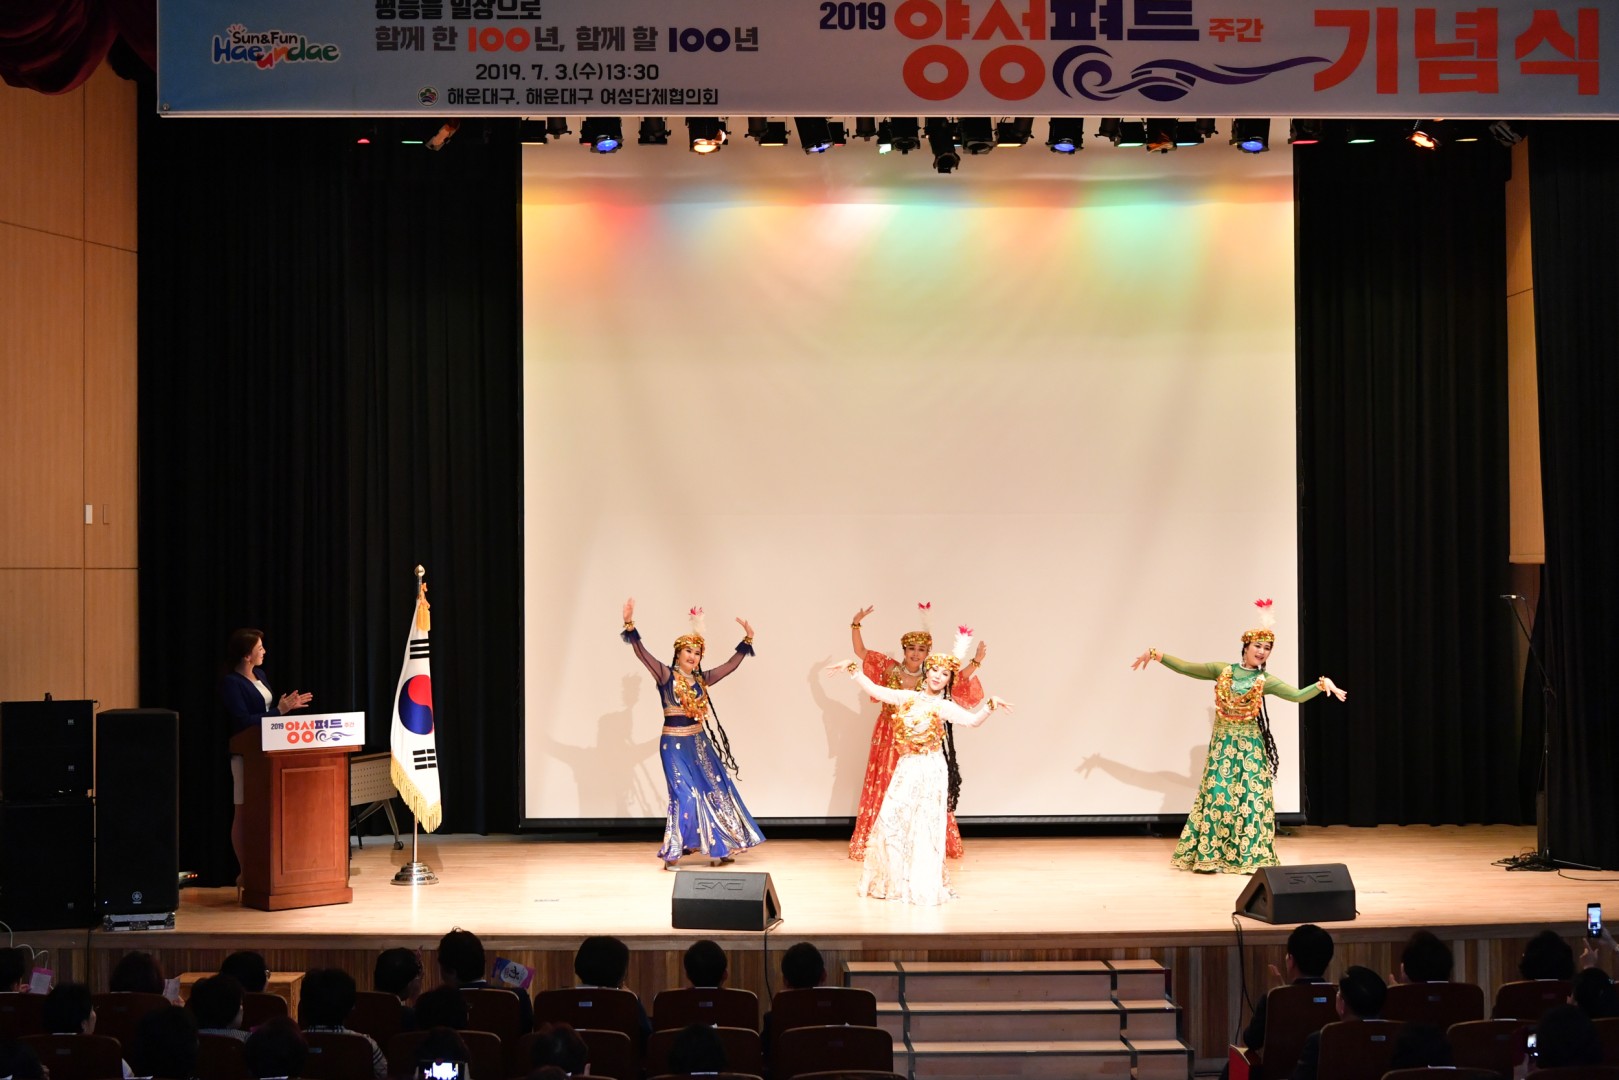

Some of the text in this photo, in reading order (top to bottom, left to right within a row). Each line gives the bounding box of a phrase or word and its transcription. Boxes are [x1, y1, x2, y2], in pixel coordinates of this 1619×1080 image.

[232, 31, 298, 45] Sun&Fun
[375, 26, 759, 53] 함께 한 100년, 함께 할 100년
[819, 1, 886, 31] 2019
[1209, 18, 1264, 42] 주간
[1314, 7, 1600, 96] 기념식
[475, 63, 526, 81] 2019.
[531, 63, 548, 81] 7.
[525, 87, 594, 105] 해운대구
[600, 87, 719, 106] 여성단체협의회
